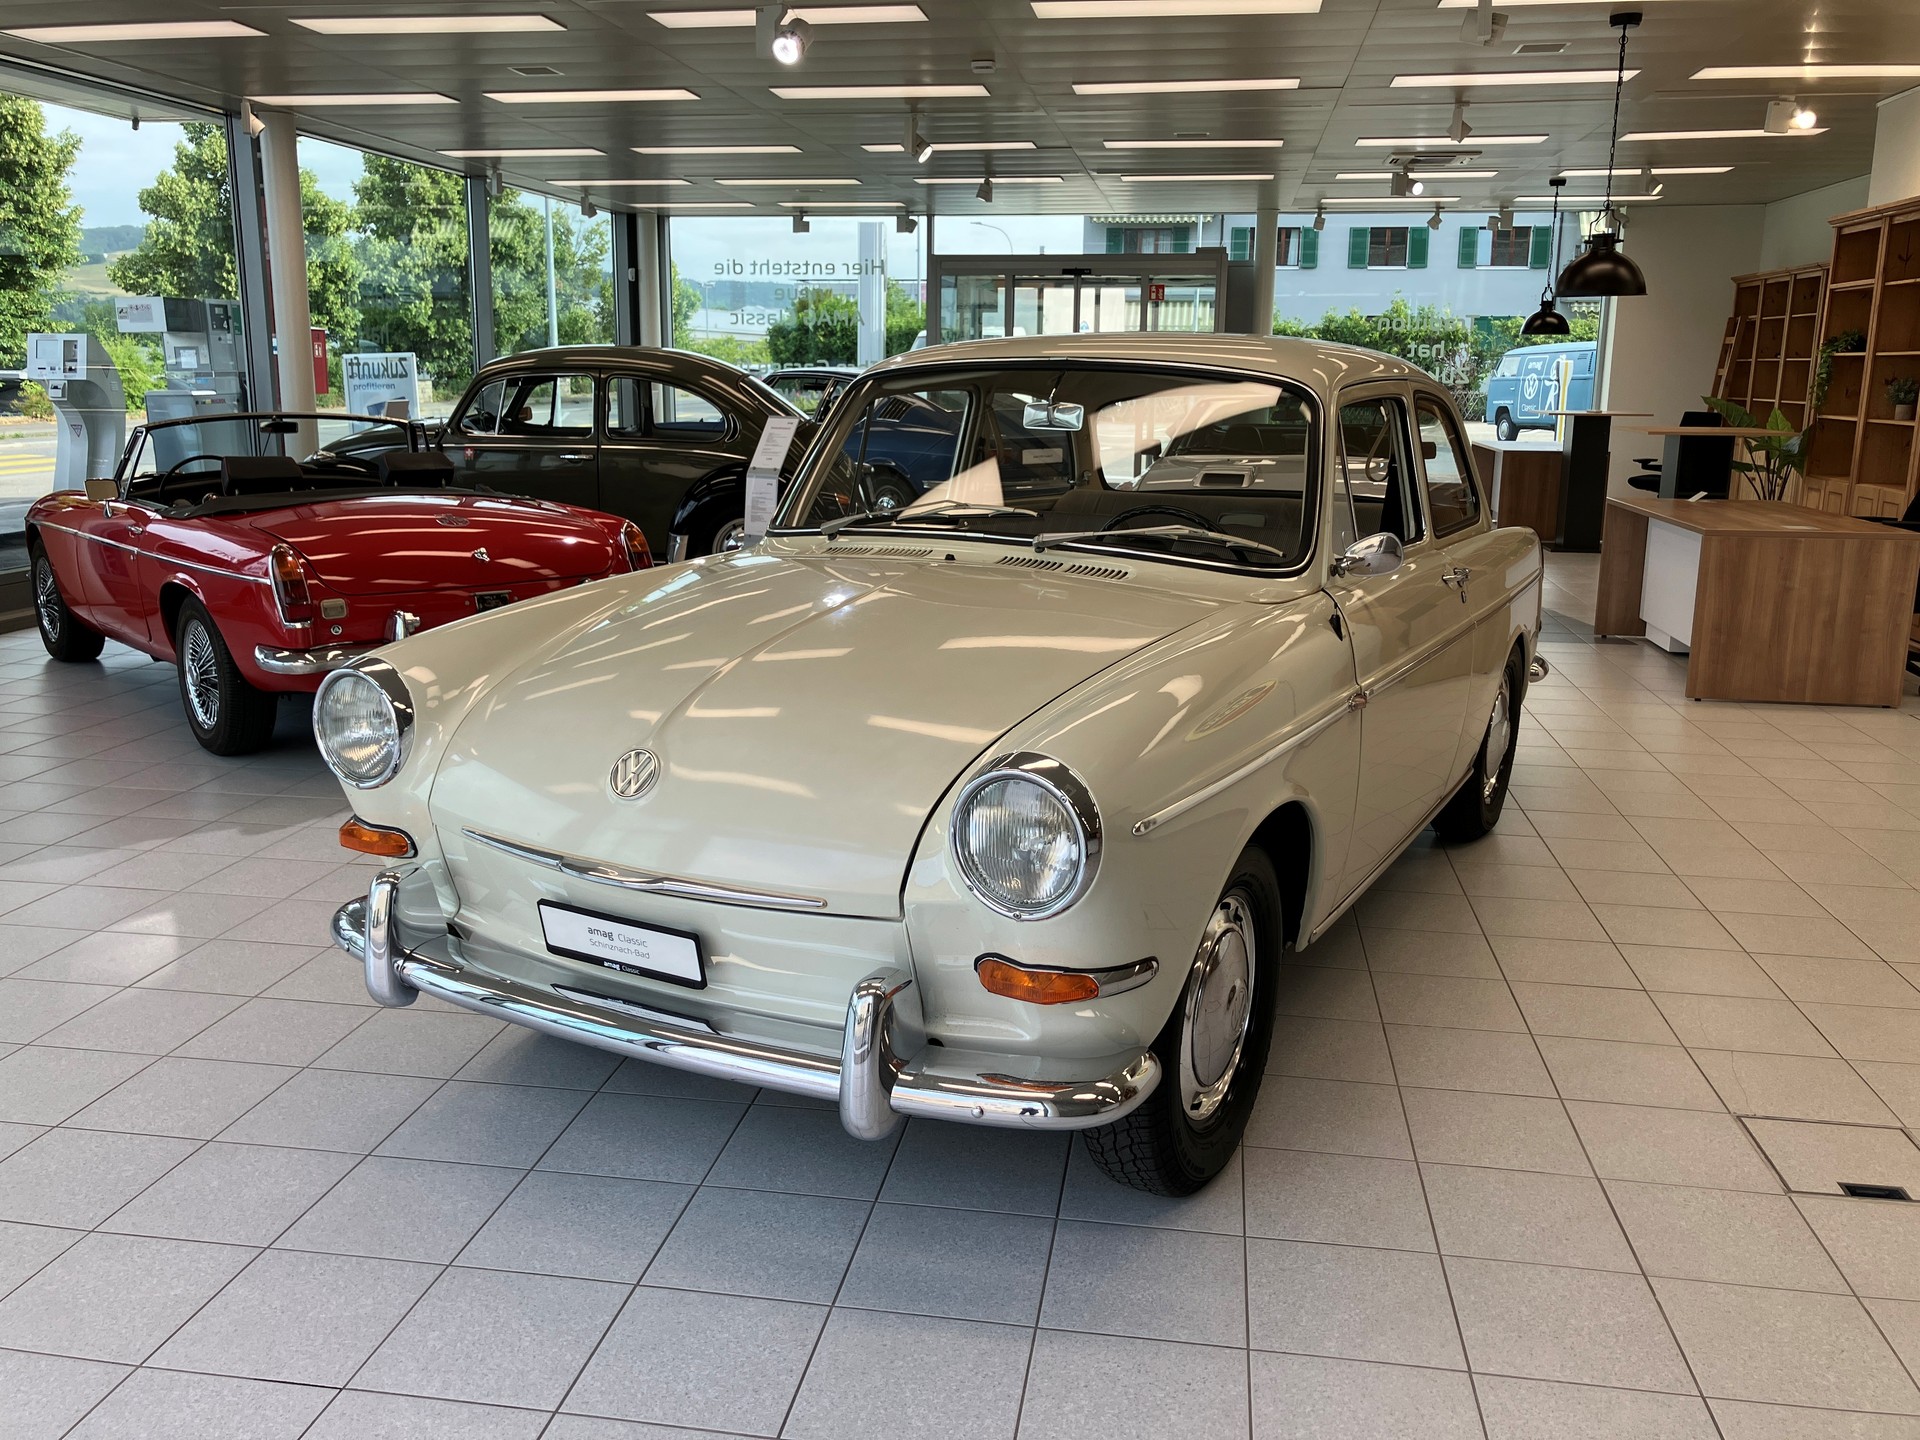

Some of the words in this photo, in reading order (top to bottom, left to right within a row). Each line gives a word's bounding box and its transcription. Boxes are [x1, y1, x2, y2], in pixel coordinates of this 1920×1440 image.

[353, 382, 396, 392] profitieren
[587, 926, 615, 942] amag
[617, 933, 649, 948] Classic
[589, 938, 650, 960] Schinznach-Bad
[603, 960, 621, 971] amag
[621, 964, 641, 975] Classic
